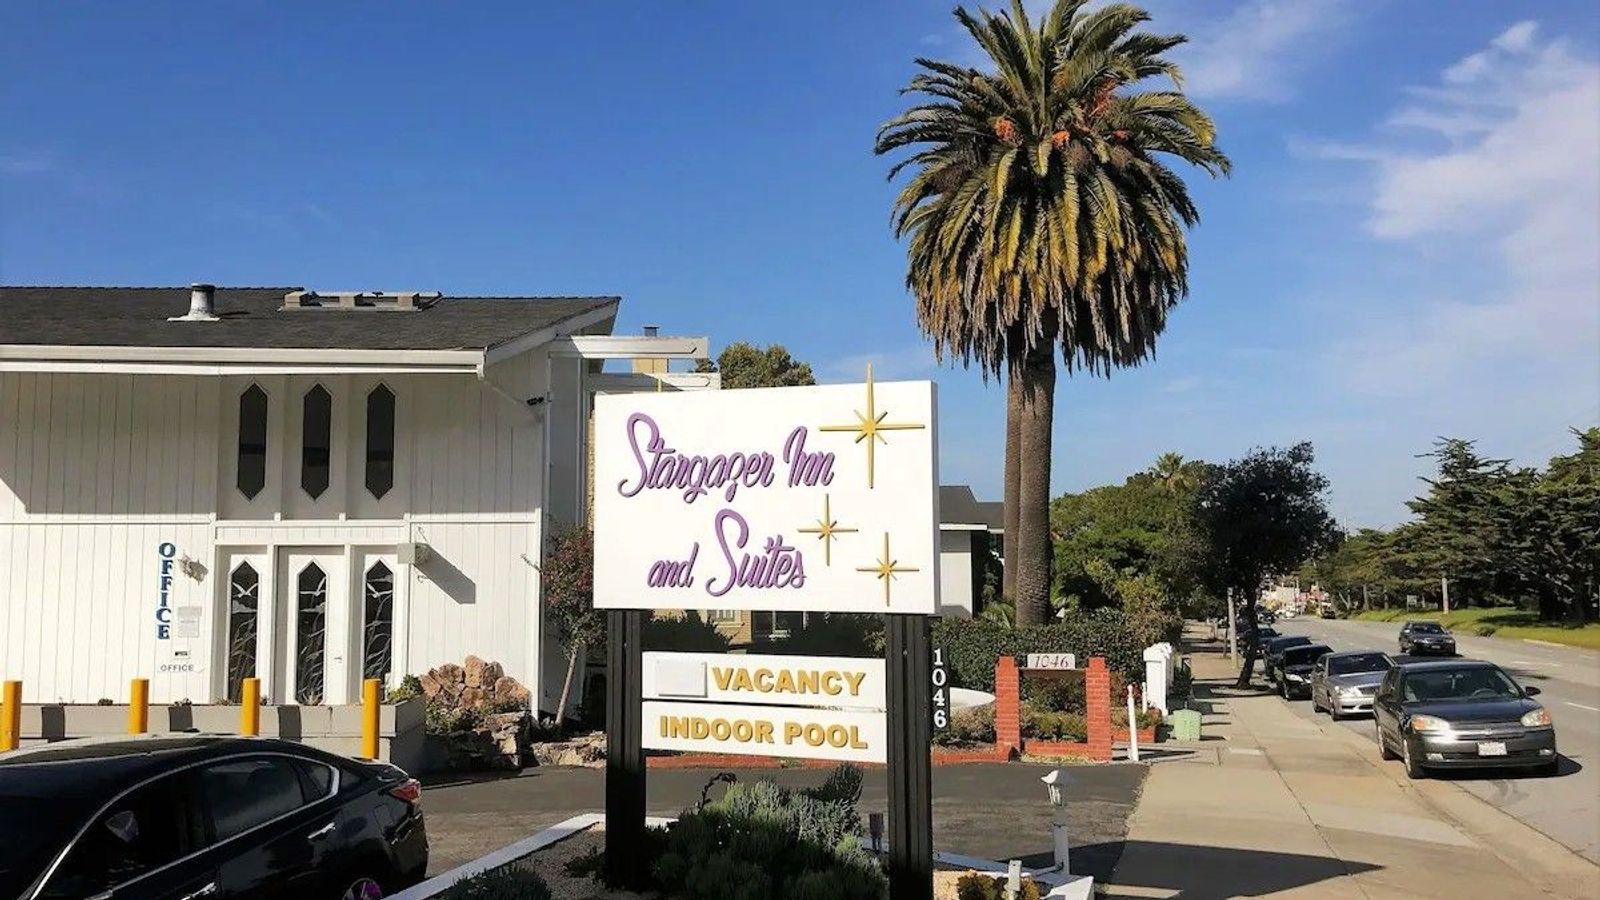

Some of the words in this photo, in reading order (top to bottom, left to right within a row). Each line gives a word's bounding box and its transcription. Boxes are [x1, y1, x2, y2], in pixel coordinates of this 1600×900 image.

[617, 412, 775, 503] Stargazer
[783, 425, 836, 488] Inn
[647, 541, 700, 588] and
[705, 508, 806, 597] Suites
[156, 542, 176, 639] OFFICE
[160, 663, 194, 672] OFFICE
[711, 666, 866, 696] VACANCY
[932, 648, 947, 728] 1046
[1034, 654, 1069, 668] 1046
[659, 715, 774, 744] INDOOR
[784, 722, 868, 750] POOL
